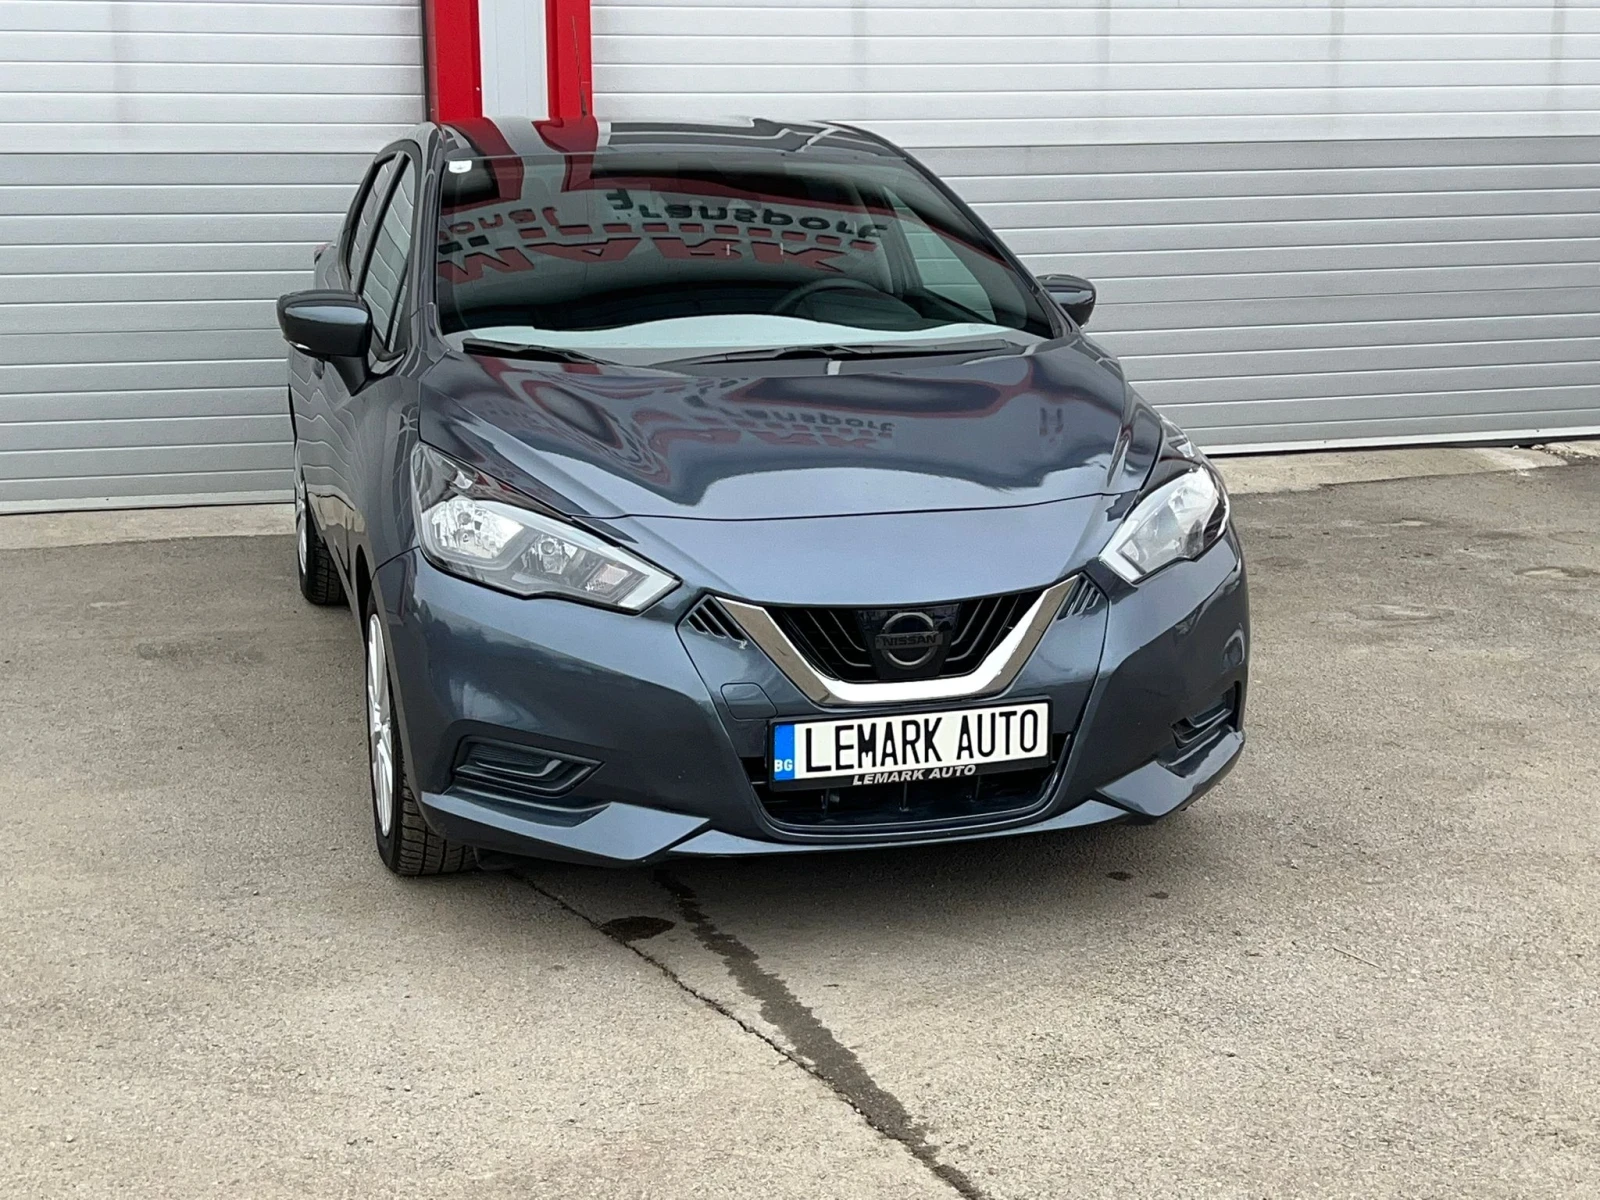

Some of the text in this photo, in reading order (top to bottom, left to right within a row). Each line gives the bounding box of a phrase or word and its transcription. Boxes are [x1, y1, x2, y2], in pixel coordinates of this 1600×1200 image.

[883, 634, 936, 647] NISSAN
[805, 709, 1039, 773] LEMARK AUTO
[774, 759, 793, 773] BG
[852, 764, 976, 786] LEMARK AUTO
